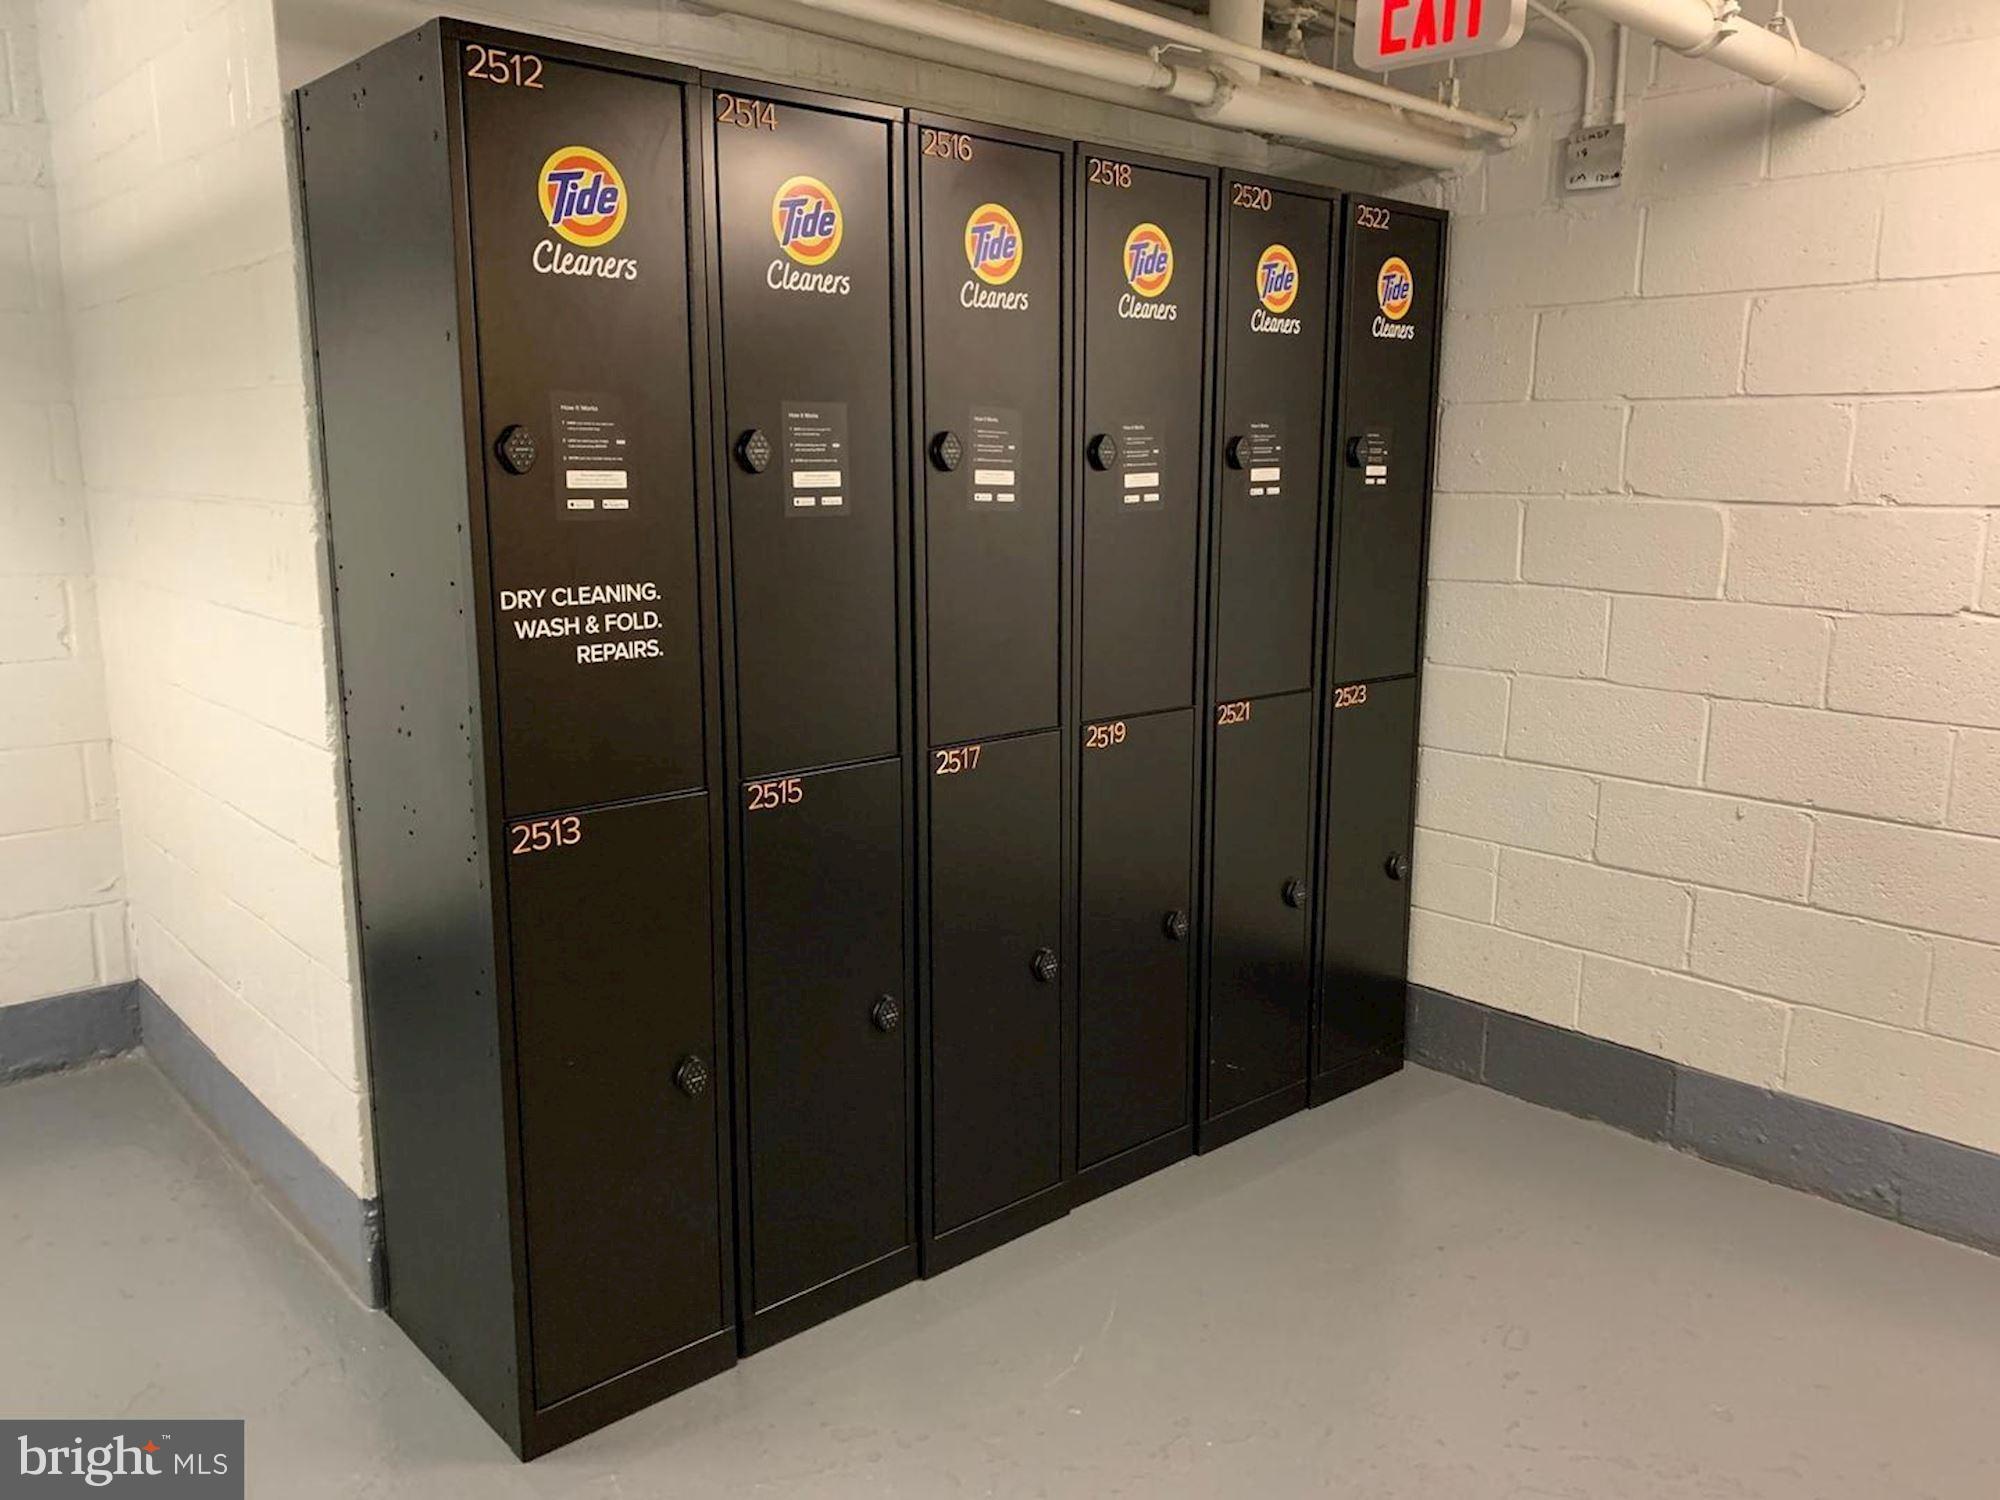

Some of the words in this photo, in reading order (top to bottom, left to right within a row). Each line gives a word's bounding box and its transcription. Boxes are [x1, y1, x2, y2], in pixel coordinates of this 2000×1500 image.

[465, 44, 544, 89] 2512
[716, 92, 777, 131] 2514
[921, 129, 973, 161] 2516
[1088, 158, 1132, 189] 2518
[547, 170, 619, 226] Tide
[1232, 183, 1272, 211] 2520
[779, 197, 836, 247] Tide
[1357, 205, 1391, 229] 2522
[531, 238, 638, 281] Cleaners
[970, 223, 1017, 269] Tide
[765, 259, 851, 296] Cleaners
[1129, 241, 1168, 283] Tide
[959, 280, 1029, 311] Cleaners
[1260, 262, 1294, 301] Tide
[1380, 274, 1410, 307] Tide
[1117, 294, 1177, 321] Cleaners
[1250, 309, 1301, 336] Cleaners
[1371, 317, 1415, 340] Cleaners
[500, 589, 546, 611] DRY
[551, 582, 662, 607] CLEANING.
[514, 617, 581, 640] WASH
[585, 614, 600, 634] &
[604, 611, 663, 633] FOLD.
[576, 639, 664, 664] REPAIRS.
[1334, 684, 1367, 708] 2523
[1217, 701, 1251, 726] 2521
[1085, 721, 1127, 749] 2519
[936, 745, 982, 776] 2517
[748, 777, 803, 812] 2515
[511, 816, 582, 855] 2513
